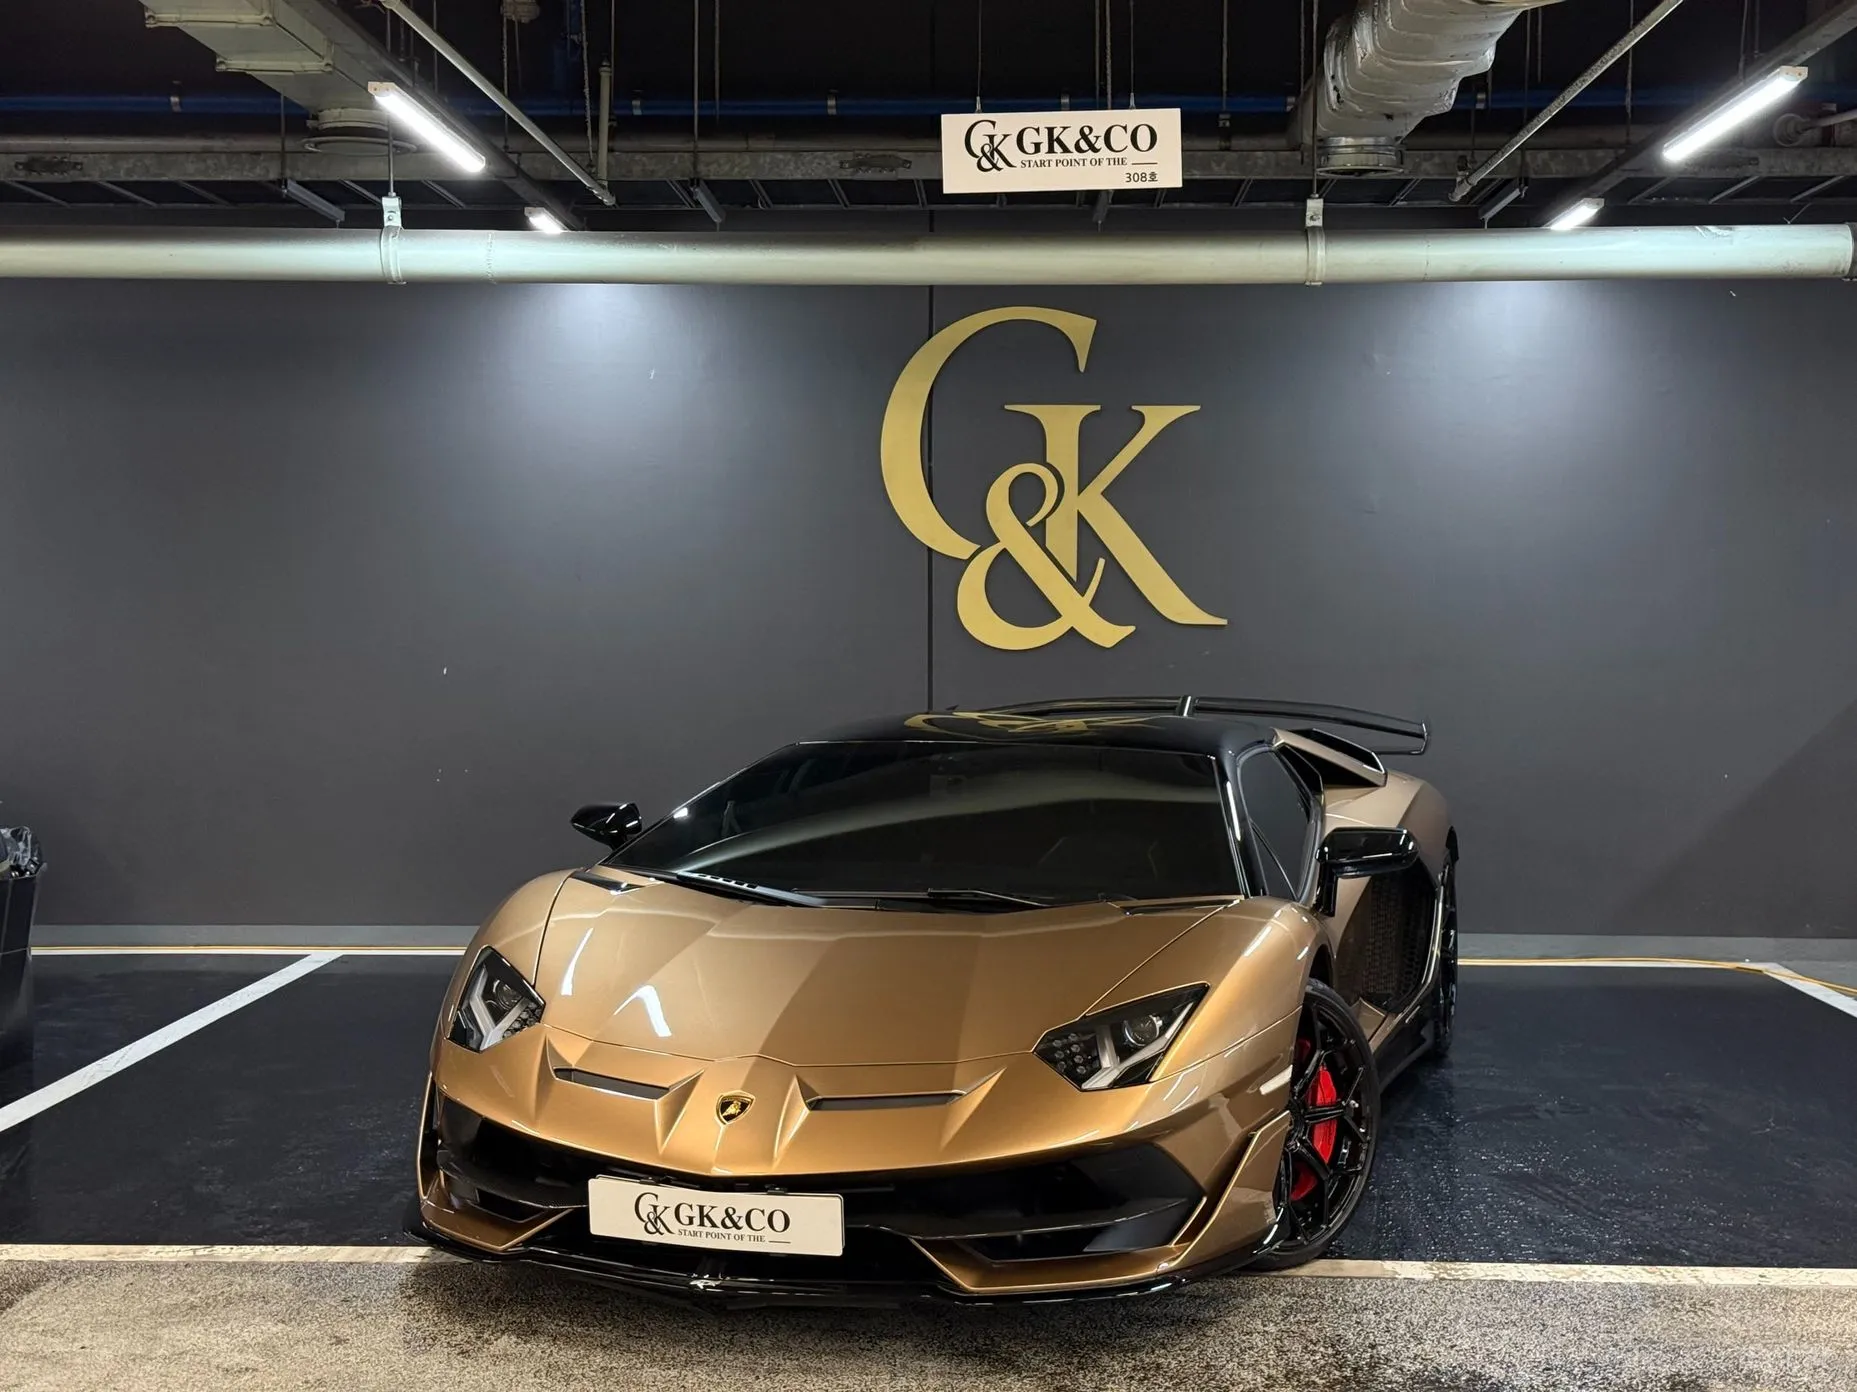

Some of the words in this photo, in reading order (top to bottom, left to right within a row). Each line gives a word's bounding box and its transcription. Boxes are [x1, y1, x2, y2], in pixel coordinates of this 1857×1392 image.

[1016, 123, 1158, 155] GK&CO
[1020, 158, 1052, 168] START
[1055, 158, 1087, 168] POINT
[1089, 157, 1105, 167] OF
[1106, 157, 1128, 166] THE
[1125, 171, 1158, 183] 308호
[674, 1202, 791, 1233] GK&CO
[678, 1229, 704, 1239] START
[705, 1231, 732, 1241] POINT
[733, 1233, 746, 1242] OF
[747, 1234, 766, 1243] THE
